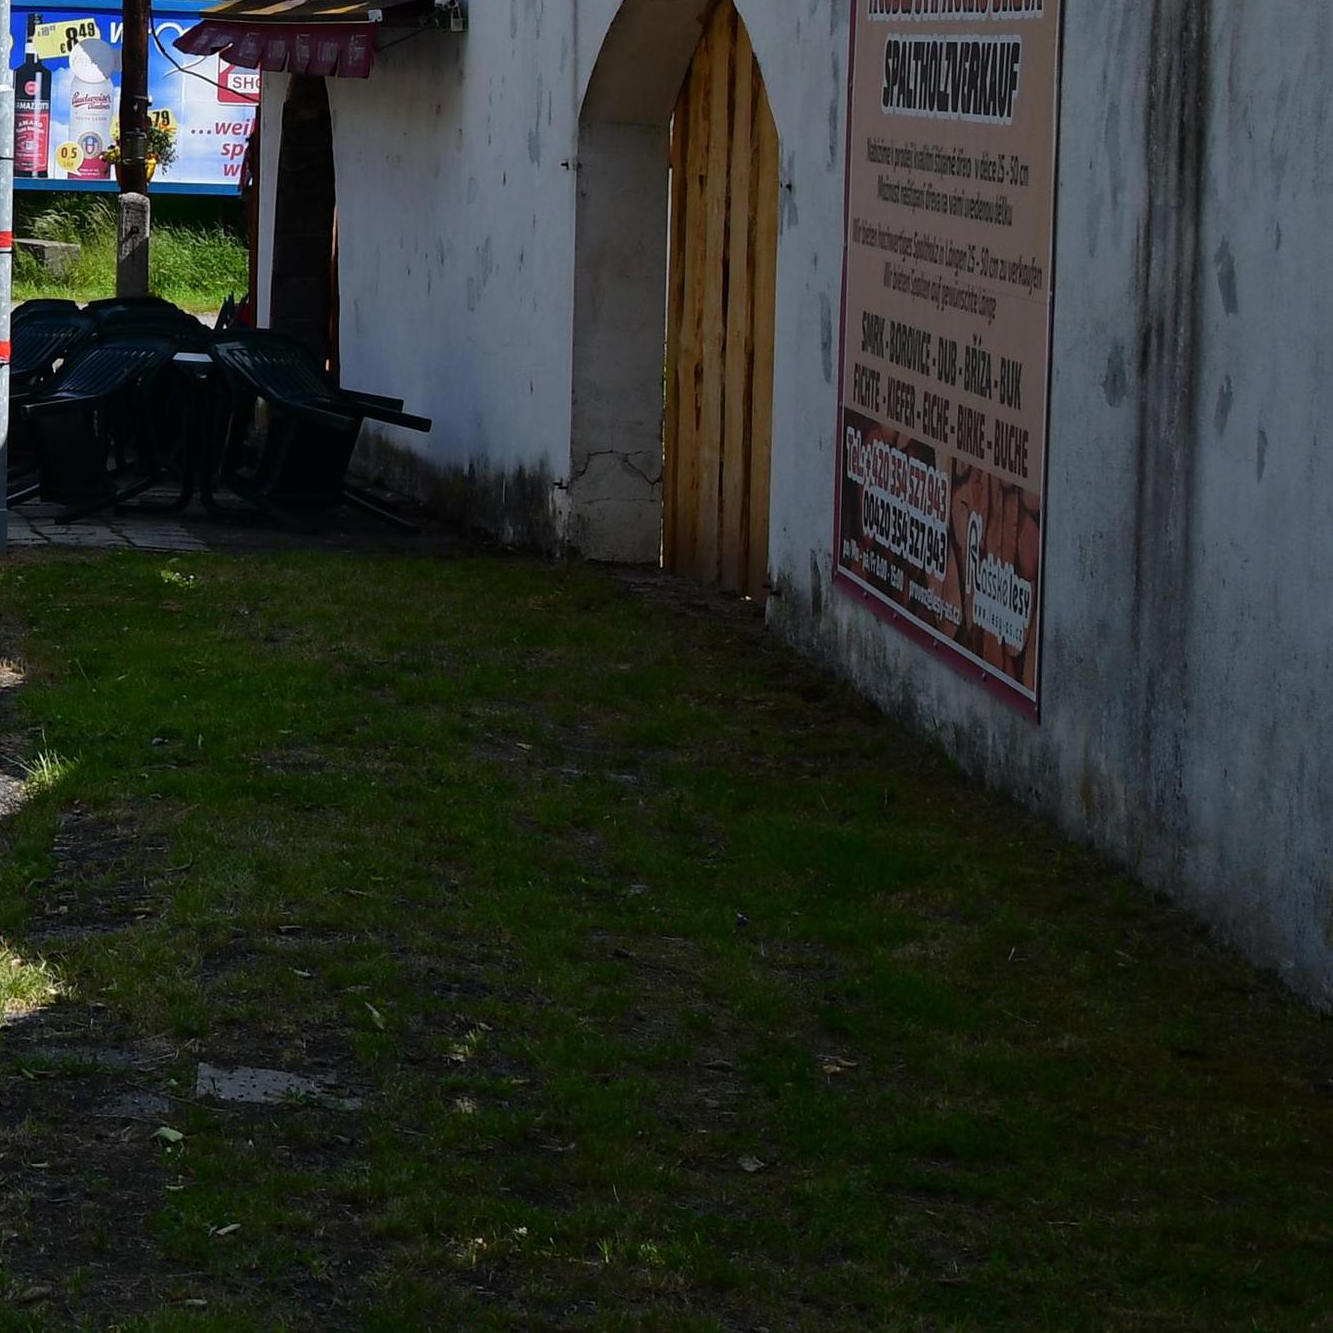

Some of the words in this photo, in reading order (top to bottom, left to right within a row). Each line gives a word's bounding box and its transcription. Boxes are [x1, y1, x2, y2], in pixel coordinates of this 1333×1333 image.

[882, 40, 1020, 118] SPALTHOLZVERKAUF
[862, 311, 885, 358] SMRK
[889, 321, 931, 376] BOROVICE
[937, 336, 956, 386] DUB
[965, 333, 992, 399] BŘÍZA
[1000, 357, 1022, 410] BUK
[854, 363, 880, 412] FICHTE
[887, 376, 915, 428] KIEFER
[923, 391, 948, 443] EICHE
[957, 404, 985, 459] BIRKE
[994, 419, 1028, 478] BUCHE
[863, 491, 890, 540] 00420
[891, 503, 908, 553] 354
[909, 513, 925, 563] 527
[926, 522, 946, 575] 943
[908, 462, 926, 512] 527
[926, 471, 947, 522] 943
